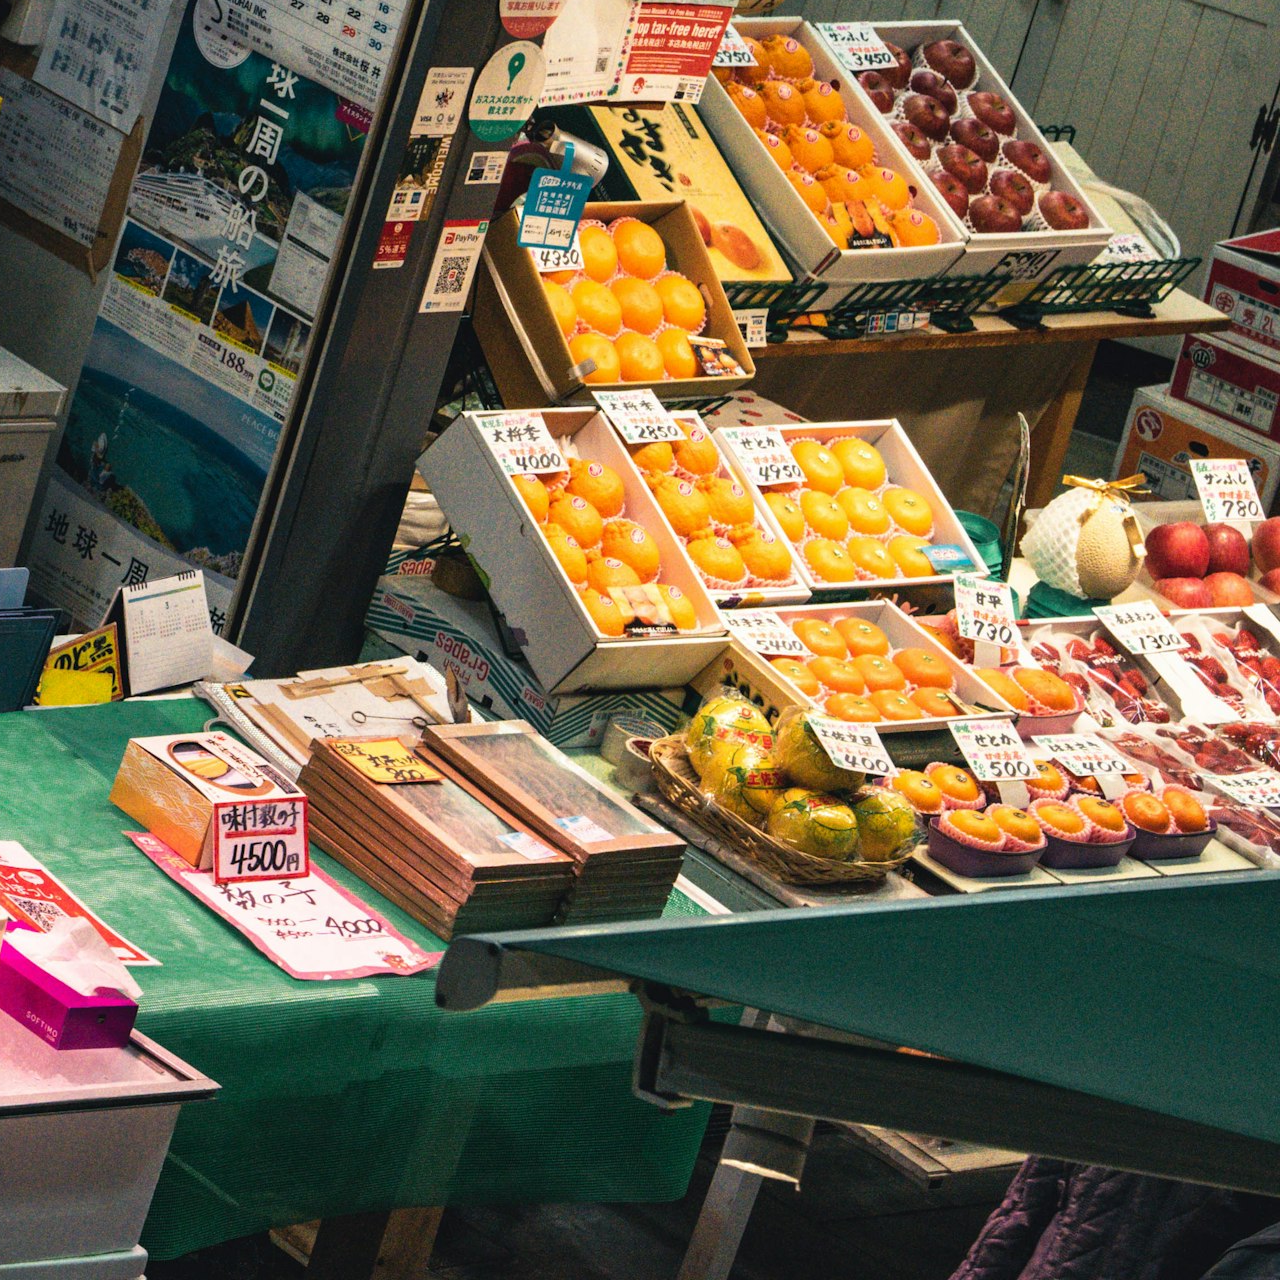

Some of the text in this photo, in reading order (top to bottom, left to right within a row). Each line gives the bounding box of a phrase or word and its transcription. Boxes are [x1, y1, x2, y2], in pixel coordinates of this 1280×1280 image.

[347, 9, 361, 20] 22
[316, 13, 382, 51] 28 30
[652, 21, 690, 37] tax-free
[854, 52, 892, 66] 3450
[475, 94, 533, 106] おススメのスポット
[427, 135, 453, 195] WELCOME
[454, 233, 480, 244] PayPay
[540, 248, 579, 267] 4350
[492, 424, 541, 444] 大将季
[634, 424, 679, 440] 2850
[515, 453, 561, 471] 4000
[758, 465, 802, 482] 4950
[1221, 499, 1260, 518] 780
[975, 591, 1003, 609] 甘平
[973, 619, 1013, 644] 730
[756, 639, 804, 652] 5400
[435, 631, 490, 683] Grapes
[843, 753, 890, 773] 400
[989, 760, 1031, 778] 500
[1082, 759, 1127, 773] 400
[221, 802, 301, 832] 味付数の子
[230, 838, 301, 875] 4500円
[25, 1010, 59, 1038] SOFTIMO
